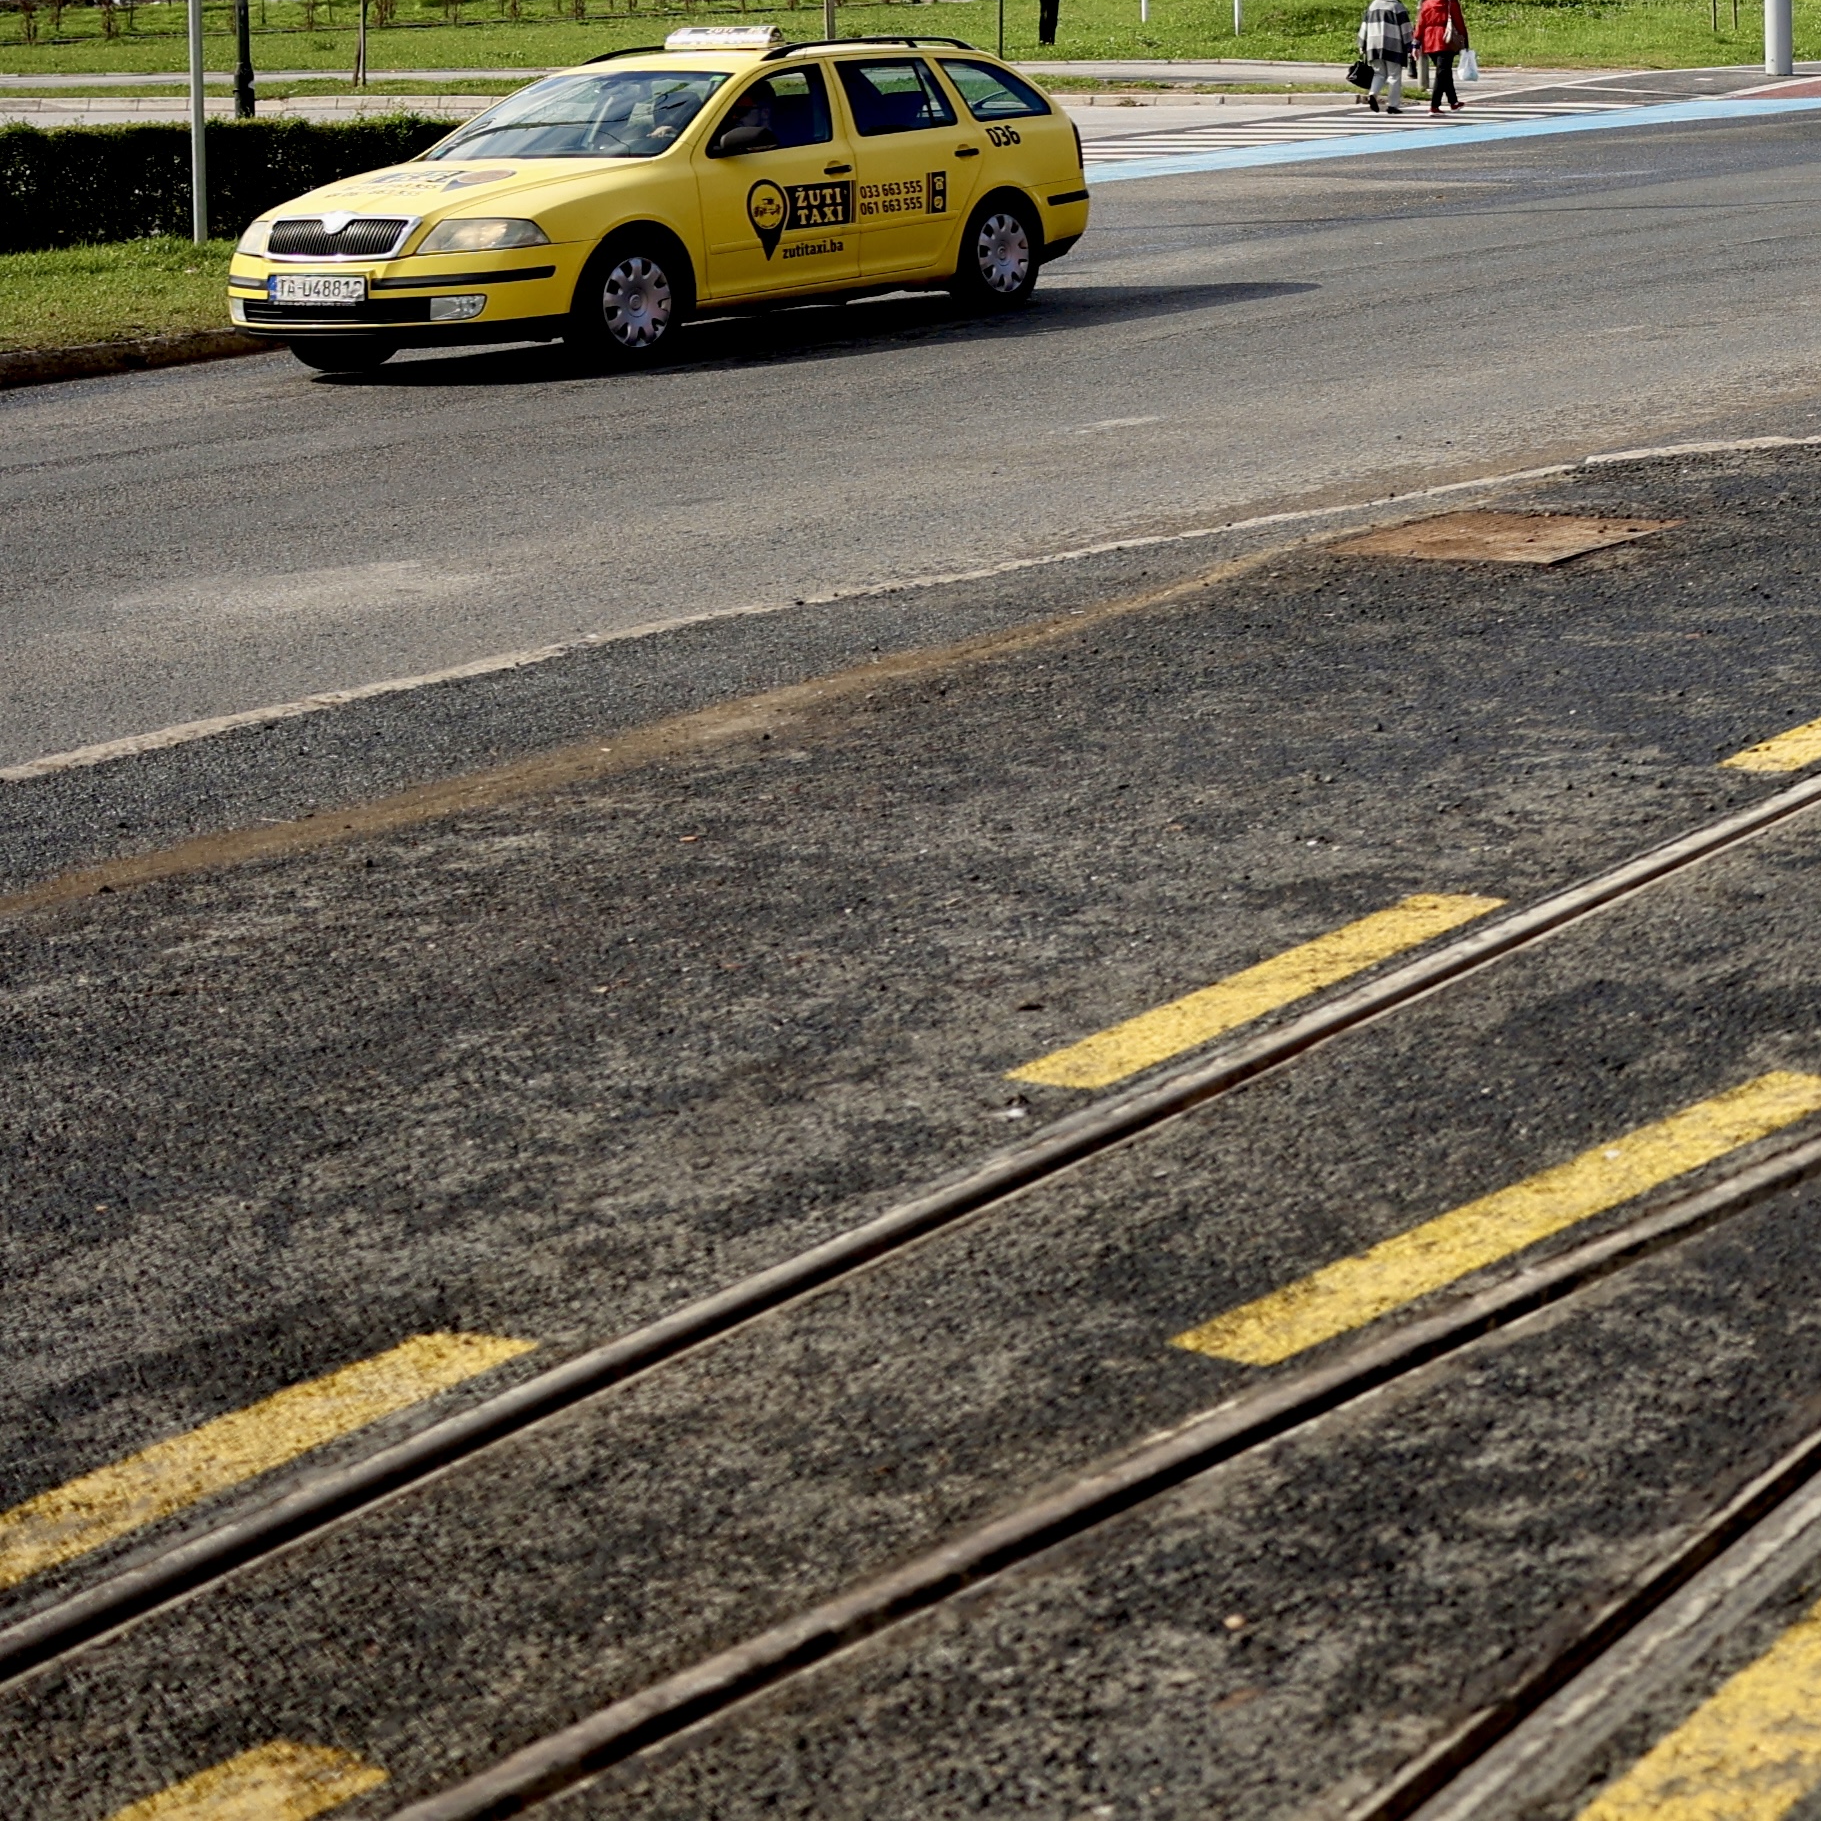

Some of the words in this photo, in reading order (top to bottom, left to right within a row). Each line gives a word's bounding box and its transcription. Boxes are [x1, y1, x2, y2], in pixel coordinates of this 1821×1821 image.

[985, 125, 1021, 147] 036
[795, 187, 842, 208] ŽUTI
[859, 183, 881, 200] 033
[882, 181, 902, 198] 663
[903, 179, 923, 195] 555
[797, 205, 844, 226] TAXI
[859, 200, 881, 217] 061
[882, 198, 902, 214] 663
[903, 196, 923, 211] 555
[783, 238, 844, 259] zutitaxi.ba
